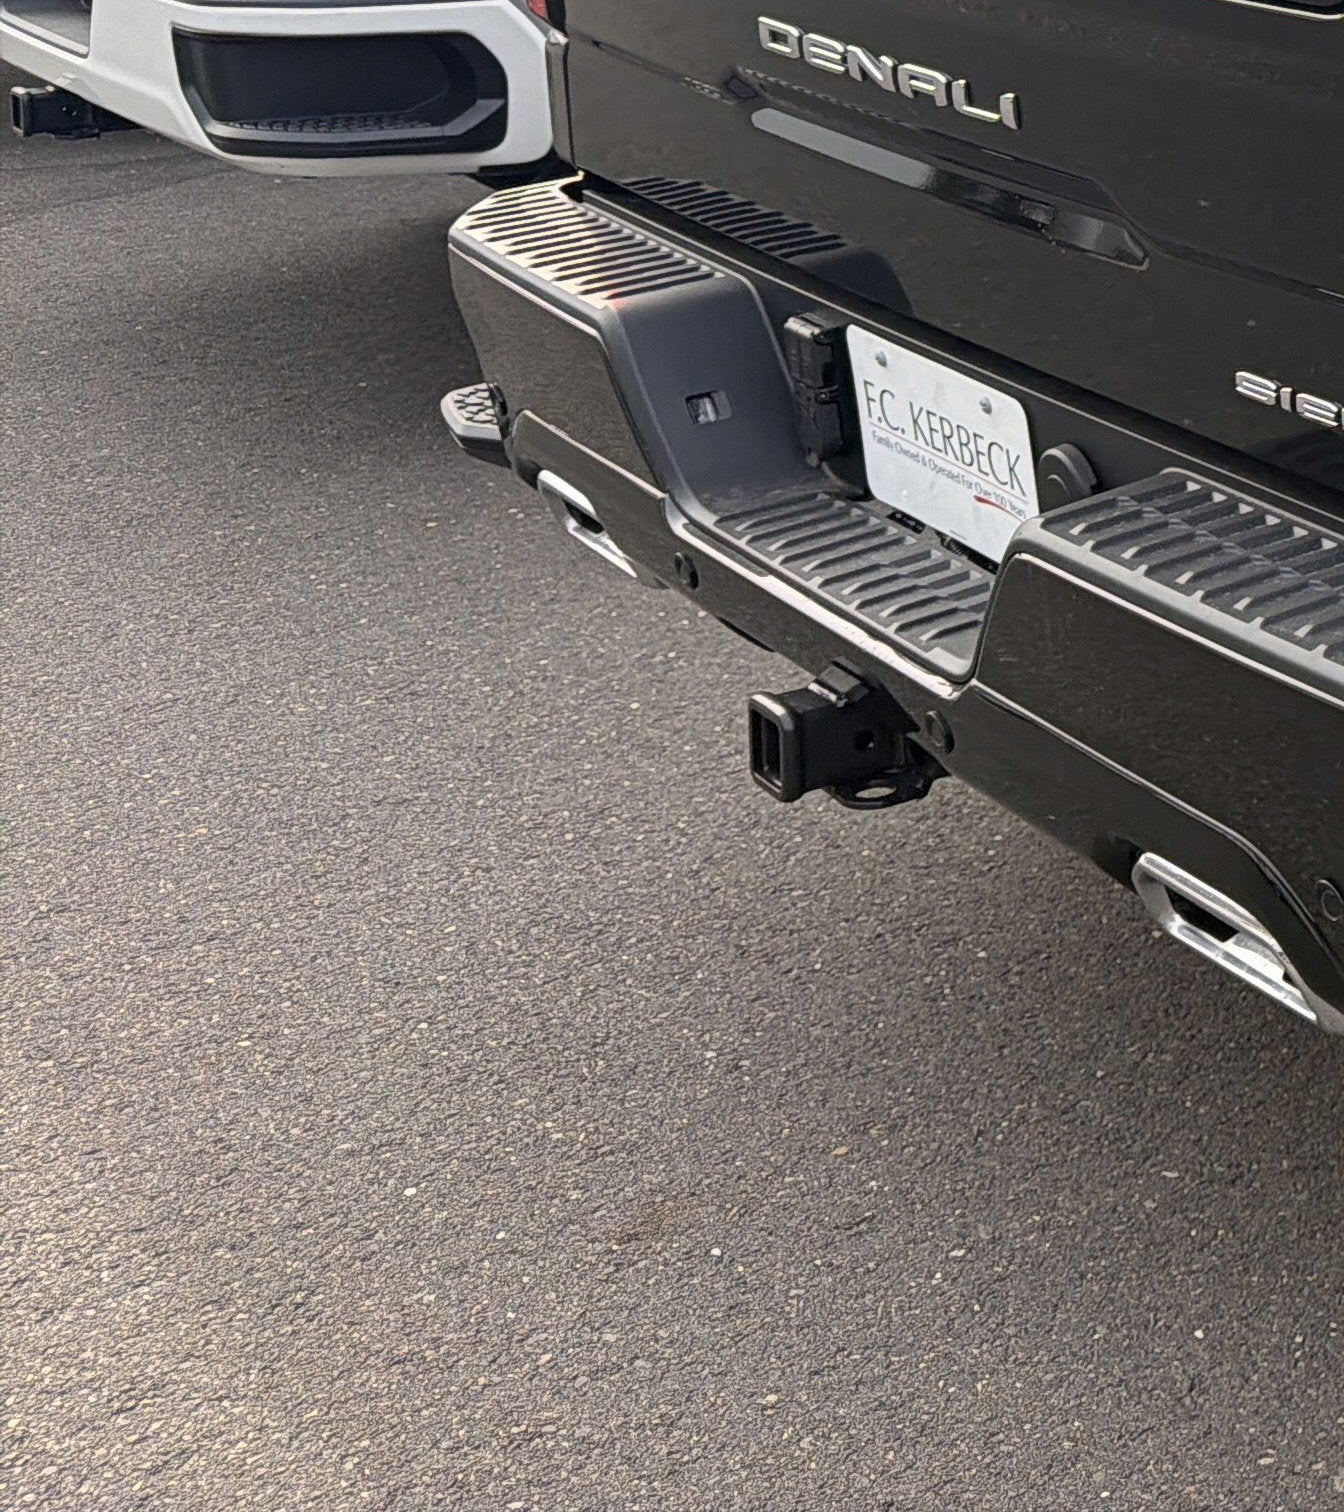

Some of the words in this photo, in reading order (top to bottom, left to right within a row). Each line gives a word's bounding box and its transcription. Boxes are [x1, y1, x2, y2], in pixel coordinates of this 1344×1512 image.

[757, 16, 1022, 130] DENALI
[863, 379, 906, 435] F.C.
[909, 400, 1027, 497] KERBECK
[894, 441, 920, 464] Owned
[961, 474, 973, 489] For
